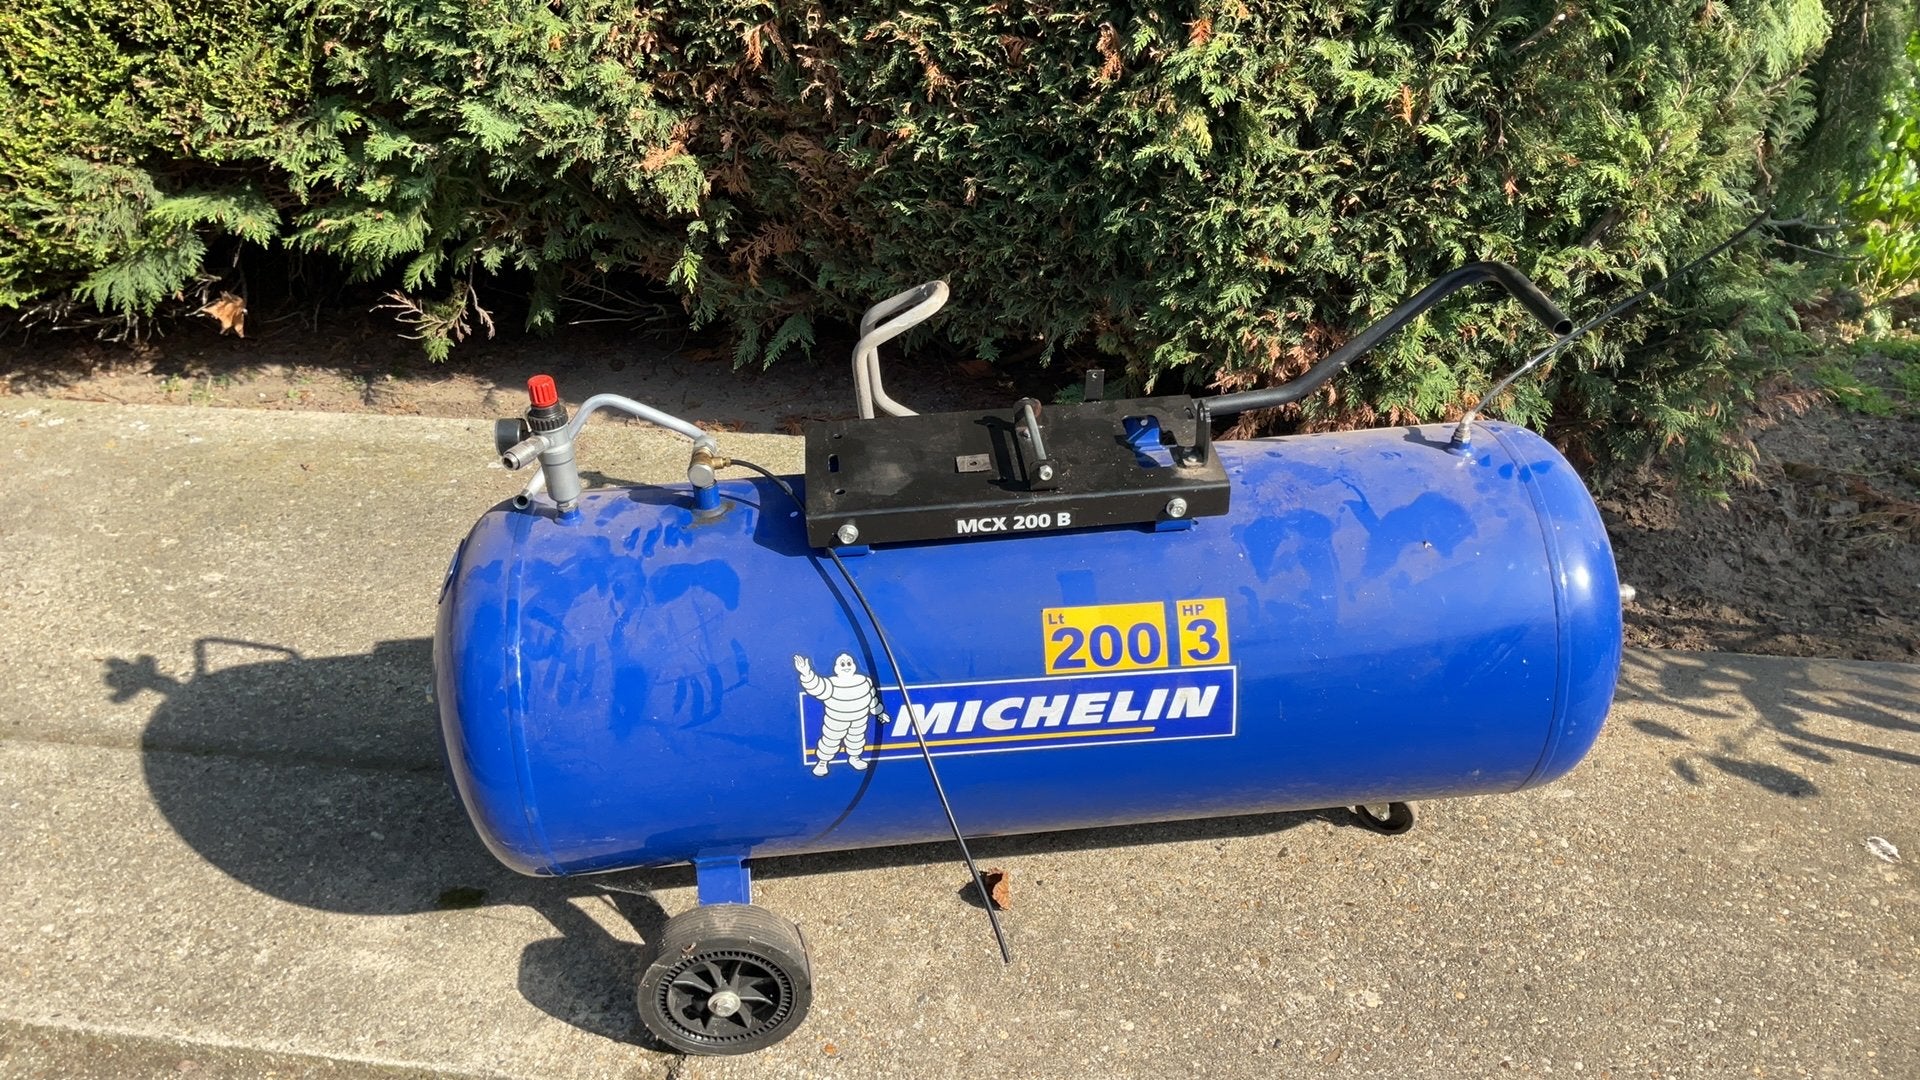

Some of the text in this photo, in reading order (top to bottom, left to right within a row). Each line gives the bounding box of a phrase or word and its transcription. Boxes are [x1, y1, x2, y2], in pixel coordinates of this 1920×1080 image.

[956, 512, 1072, 534] MCX 200 B
[1048, 613, 1065, 626] Lt
[1182, 604, 1206, 617] HP
[1051, 621, 1162, 671] 200
[1186, 618, 1221, 662] 3
[891, 684, 1220, 737] MICHELIN
